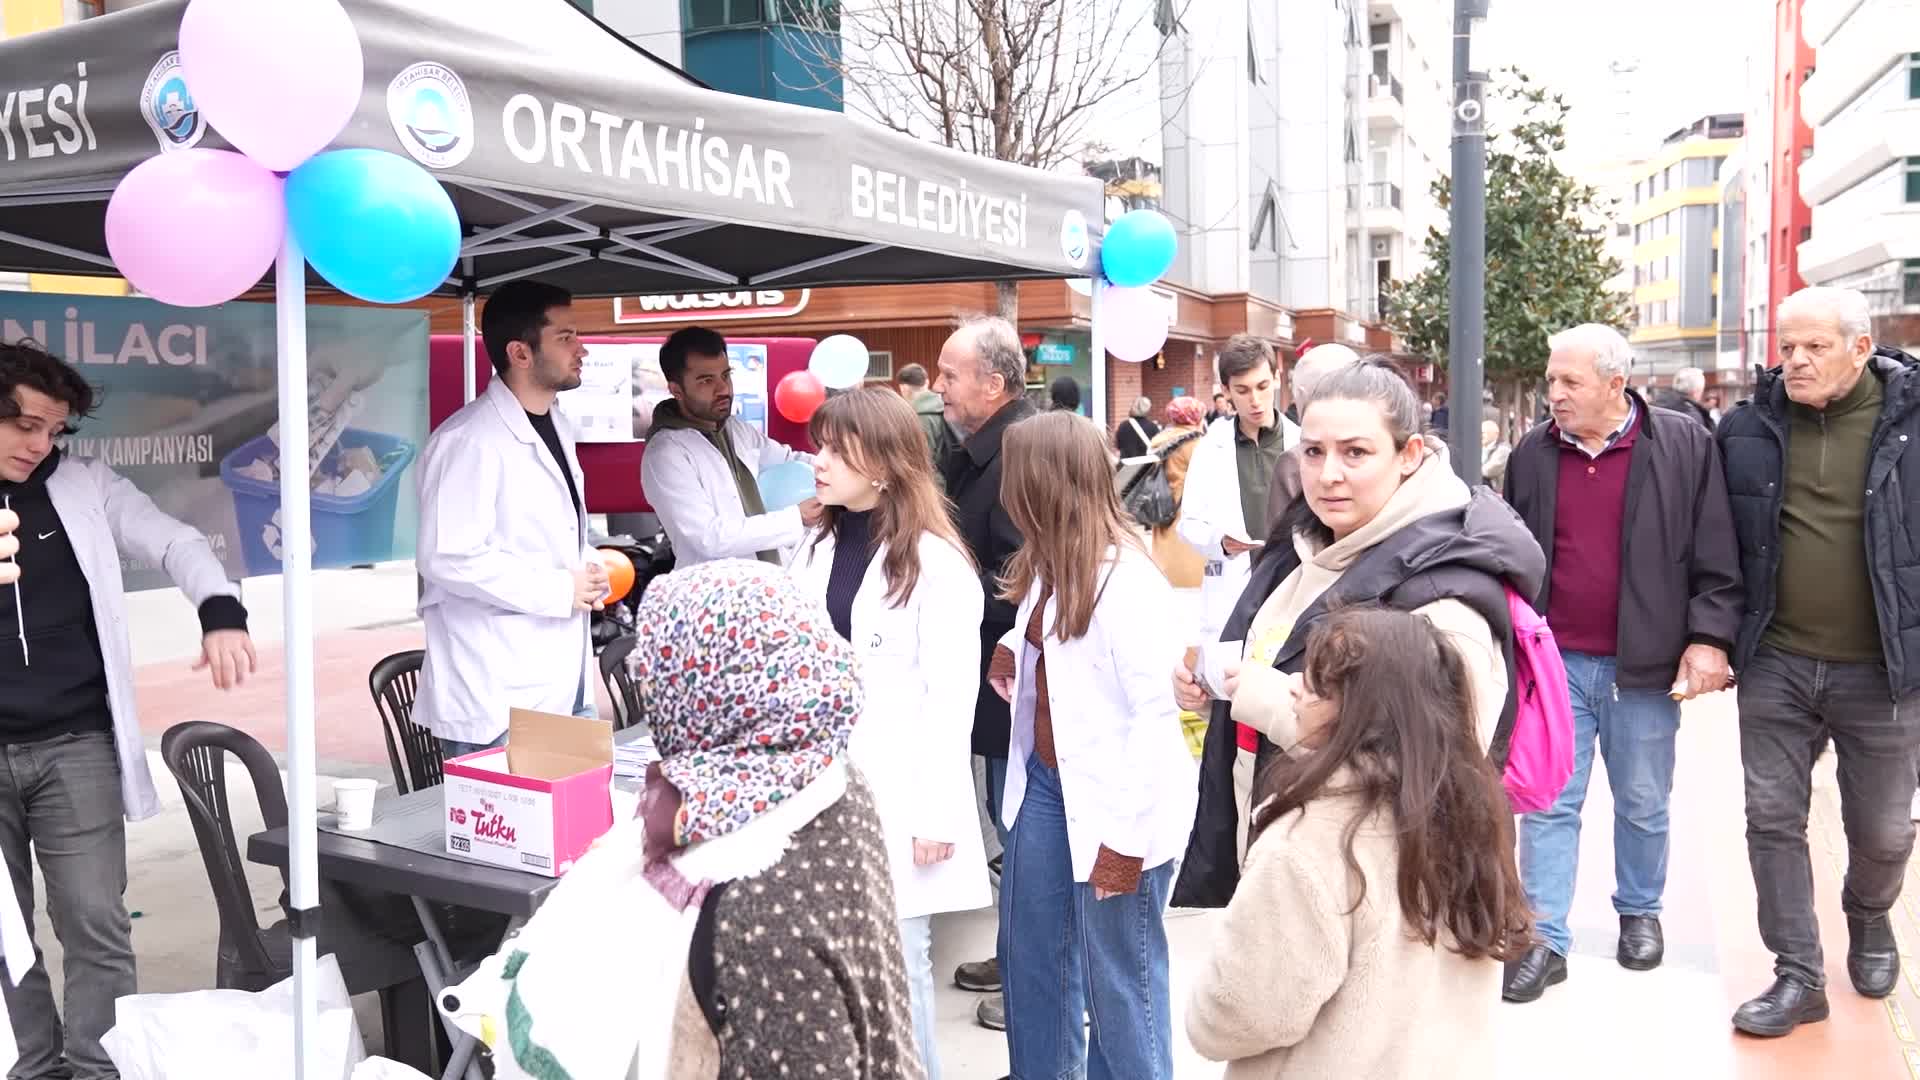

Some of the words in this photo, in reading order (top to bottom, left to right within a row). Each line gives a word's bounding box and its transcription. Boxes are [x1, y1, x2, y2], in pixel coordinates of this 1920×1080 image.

[502, 92, 794, 209] ORTAHİSAR
[851, 163, 1027, 249] BELEDİYESİ
[64, 306, 208, 366] İLACI
[100, 434, 213, 467] KAMPANYASI
[471, 809, 516, 843] Tutku
